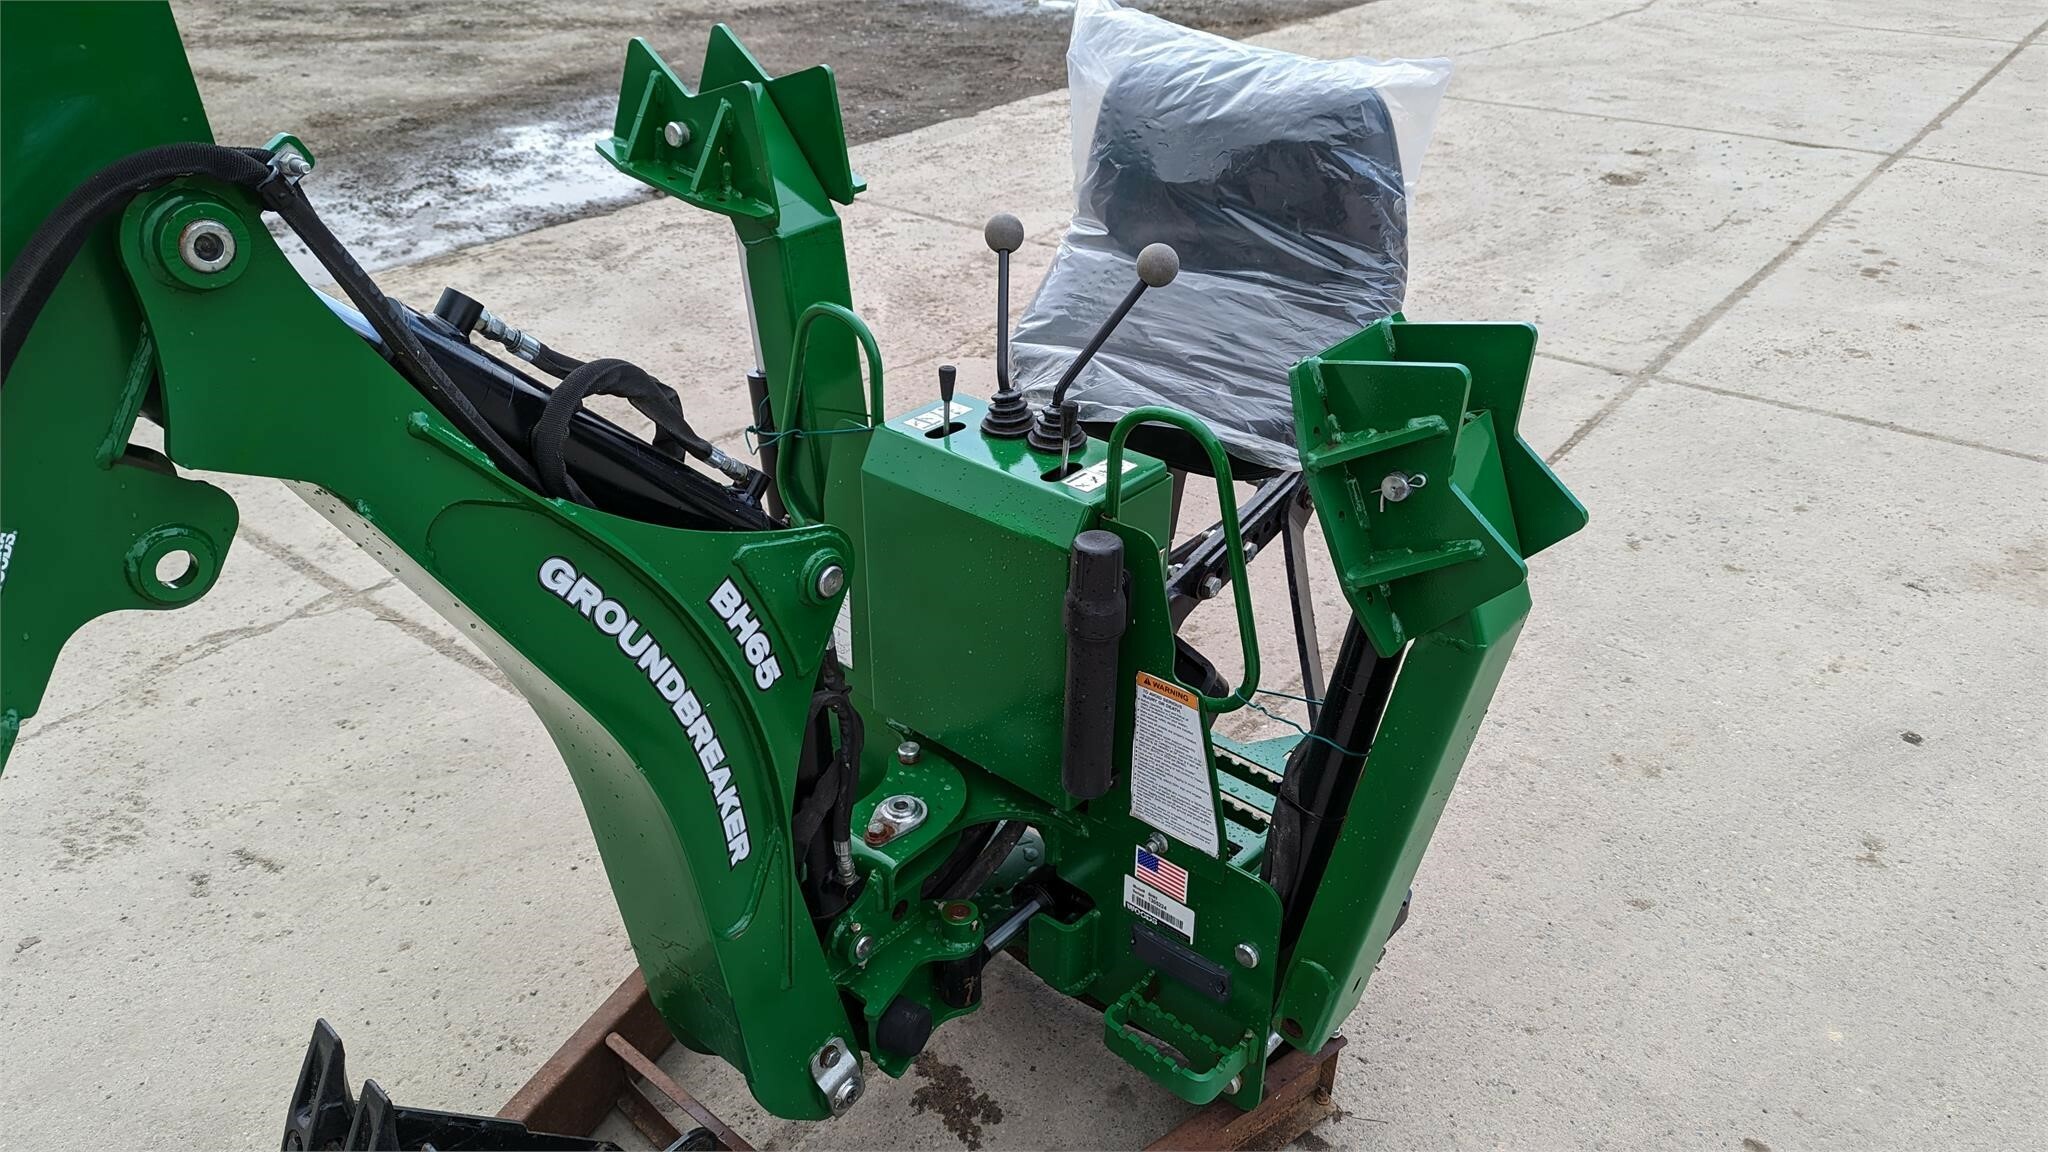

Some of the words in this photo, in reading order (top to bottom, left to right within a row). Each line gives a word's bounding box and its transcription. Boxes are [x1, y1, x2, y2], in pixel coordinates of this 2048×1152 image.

[707, 576, 783, 691] BH65
[537, 556, 751, 871] GROUNDBREAKER
[1153, 681, 1189, 702] WARNING
